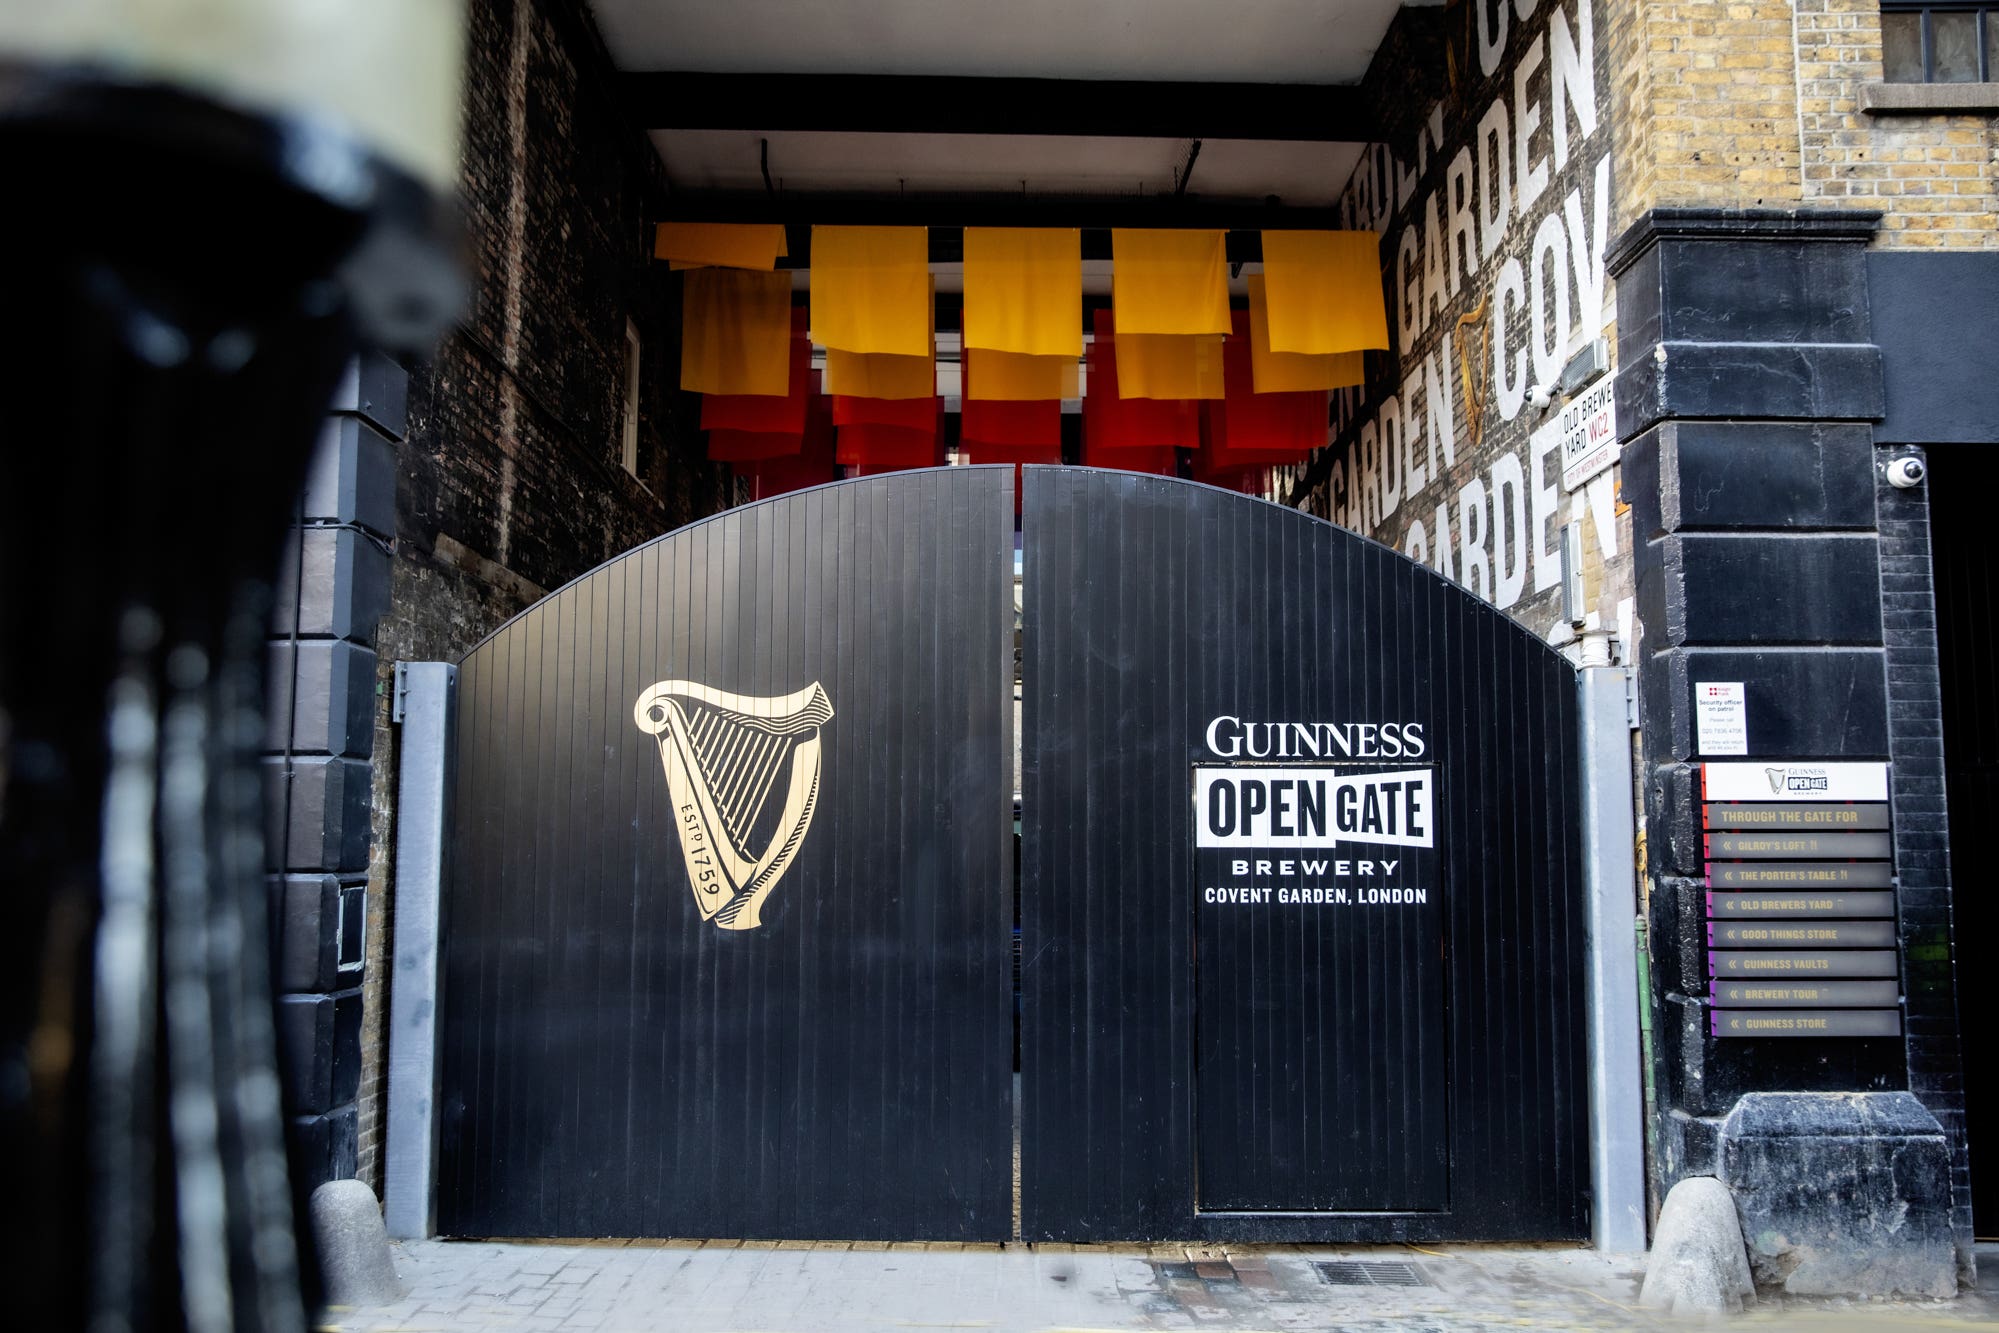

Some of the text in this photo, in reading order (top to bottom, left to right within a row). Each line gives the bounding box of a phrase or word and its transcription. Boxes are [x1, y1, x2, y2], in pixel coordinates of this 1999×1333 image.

[1397, 0, 1598, 356] GARDEN
[1563, 406, 1578, 434] OLD
[1565, 412, 1609, 460] YARD WC2
[1206, 715, 1425, 757] GUINNESS
[1789, 778, 1827, 789] OPEN GATE
[1208, 778, 1425, 838] OPEN GATE
[1722, 811, 1858, 823] THROUGH THE GATE FOR
[1738, 841, 1806, 851] GILROY'S LOFT
[691, 847, 720, 895] 1759
[1232, 860, 1399, 876] BREWERY
[1739, 871, 1836, 880] THE PORTER'S TABLE
[1205, 888, 1427, 906] COVENT GARDEN, LONDON
[1741, 900, 1833, 910] OLD BREWERS YARD
[1741, 930, 1838, 939] GOOD THINGS STORE
[1743, 959, 1829, 969] GUINNESS VAULTS
[1745, 990, 1818, 999] BREWERY TOUR
[1746, 1019, 1827, 1029] GUINNESS STORE
